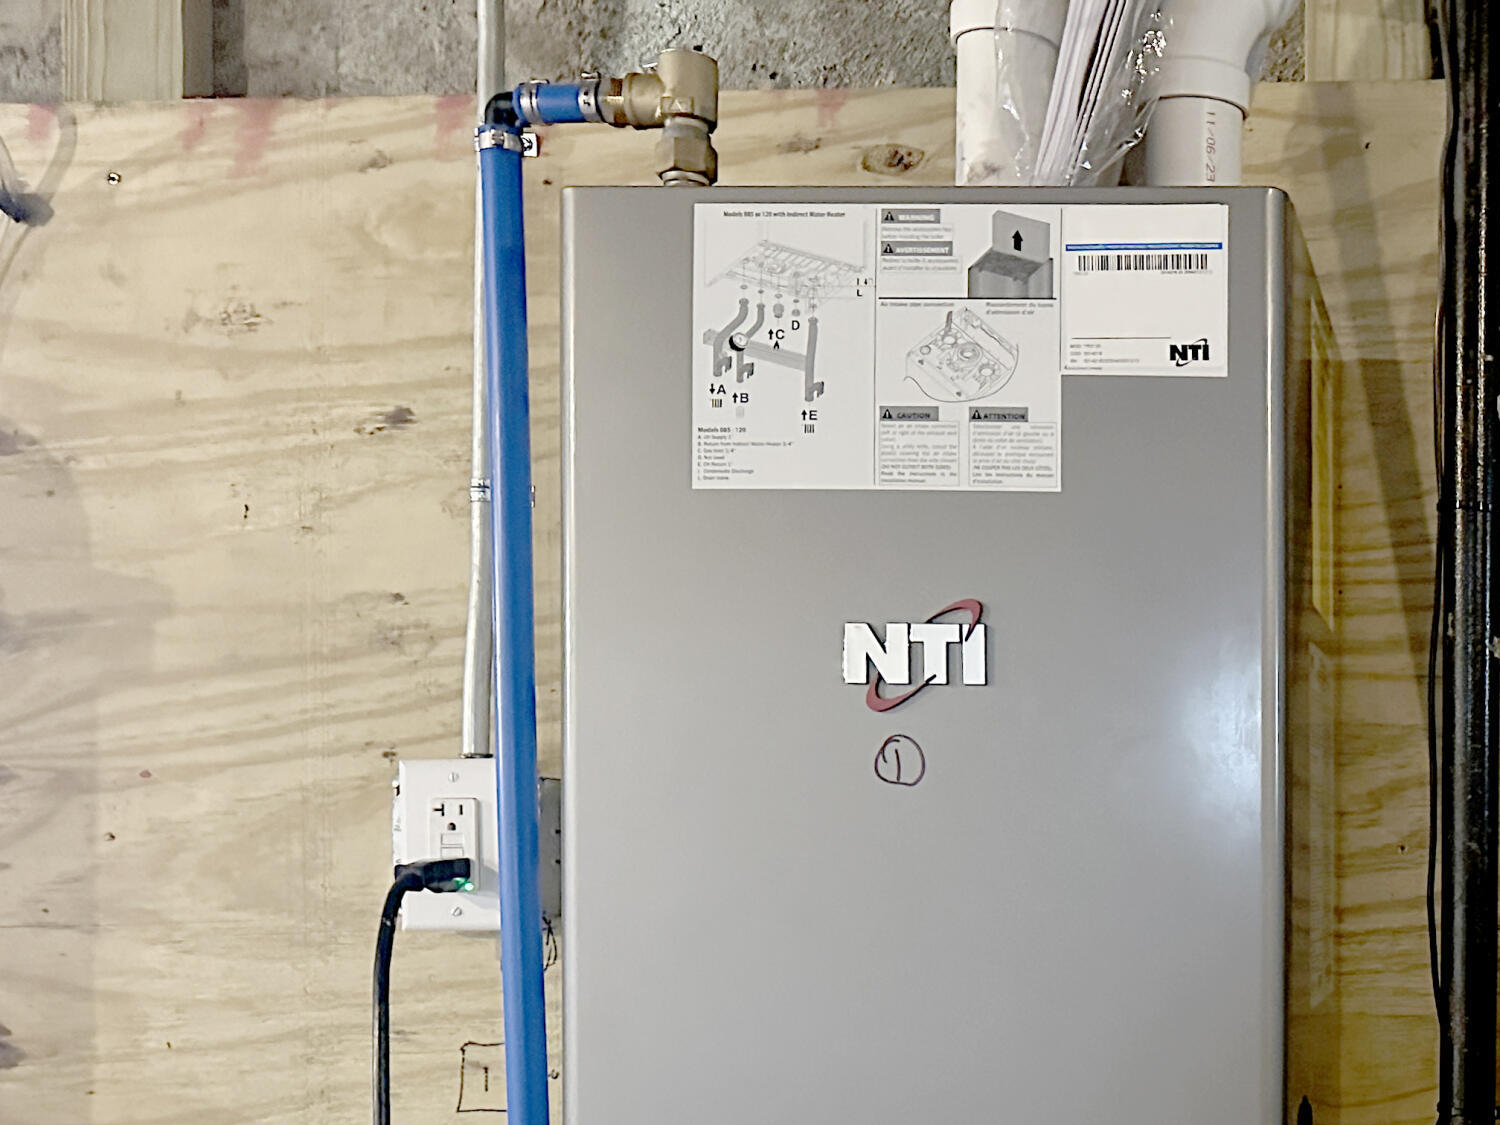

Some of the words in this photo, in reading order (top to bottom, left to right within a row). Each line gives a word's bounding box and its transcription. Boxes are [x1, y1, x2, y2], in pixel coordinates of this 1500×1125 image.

[1206, 111, 1216, 182] 11/06/23
[791, 320, 800, 331] D
[776, 329, 786, 340] C
[1170, 344, 1210, 361] NTI
[716, 384, 726, 395] A
[740, 393, 749, 404] B
[809, 410, 818, 420] E
[842, 621, 987, 685] NTI
